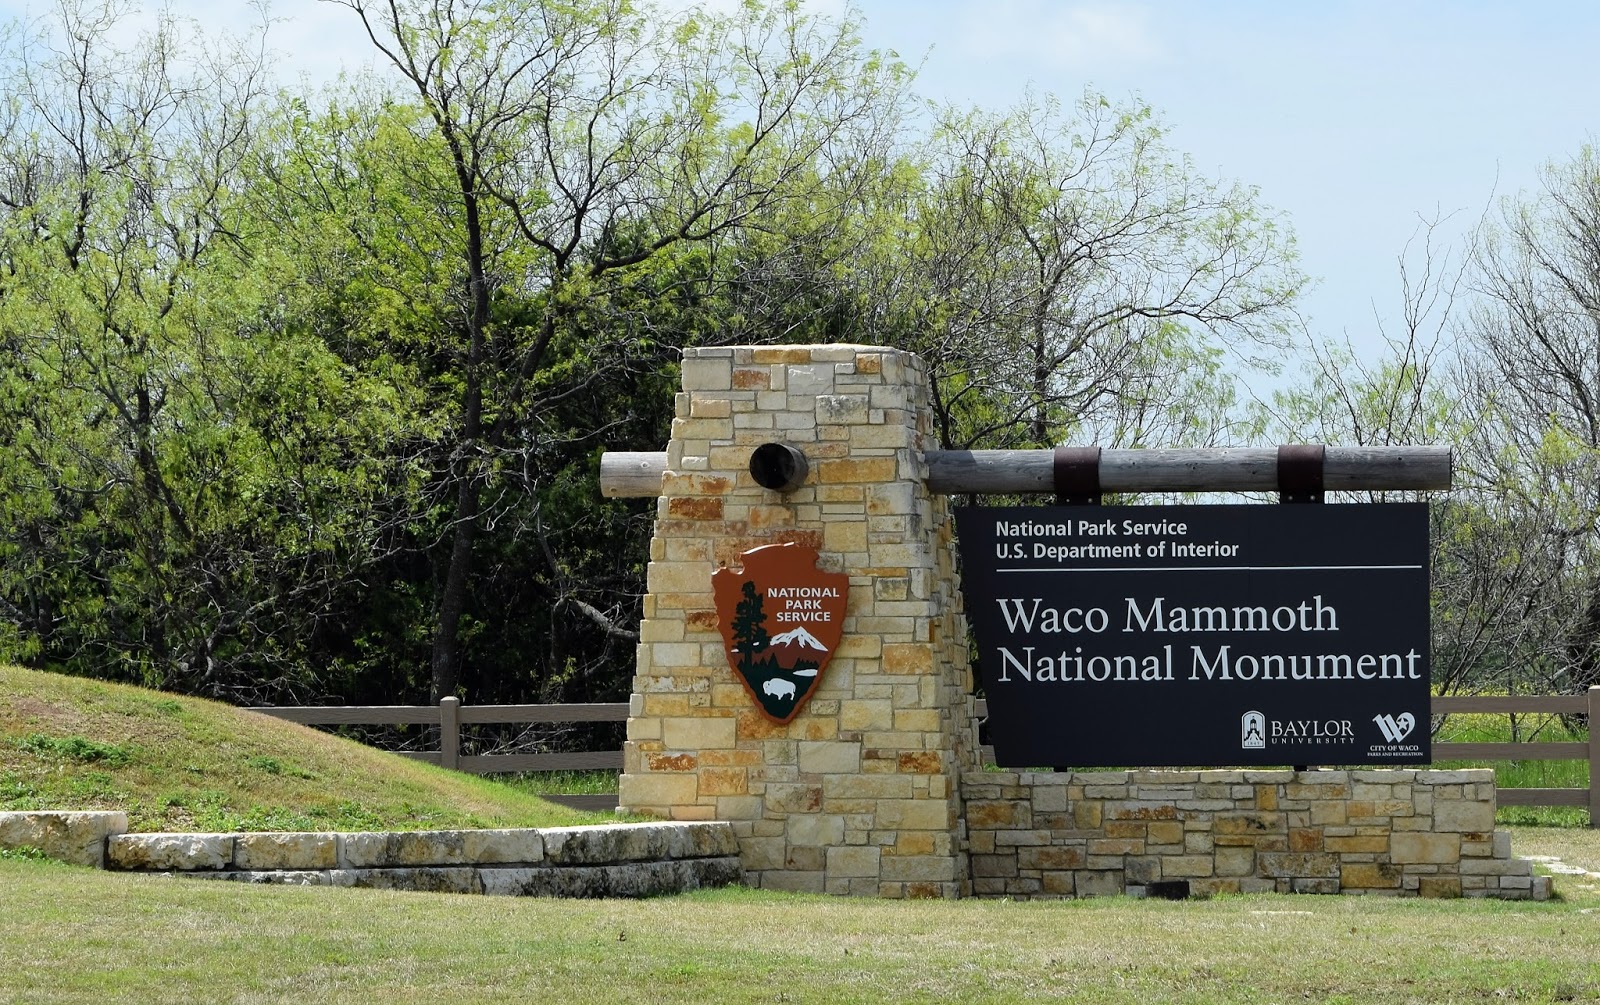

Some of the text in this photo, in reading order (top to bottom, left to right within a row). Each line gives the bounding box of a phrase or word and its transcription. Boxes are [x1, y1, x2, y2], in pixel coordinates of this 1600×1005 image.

[996, 519, 1188, 537] National Park Service
[996, 541, 1240, 563] U.S. Department of Interior
[768, 587, 840, 598] NATIONAL
[786, 599, 822, 610] PARK
[776, 611, 831, 622] SERVICE
[996, 594, 1340, 634] Waco Mammoth
[997, 644, 1421, 683] National Monument
[1271, 720, 1355, 737] BAYLOR
[1271, 737, 1355, 745] UNIVERSITY
